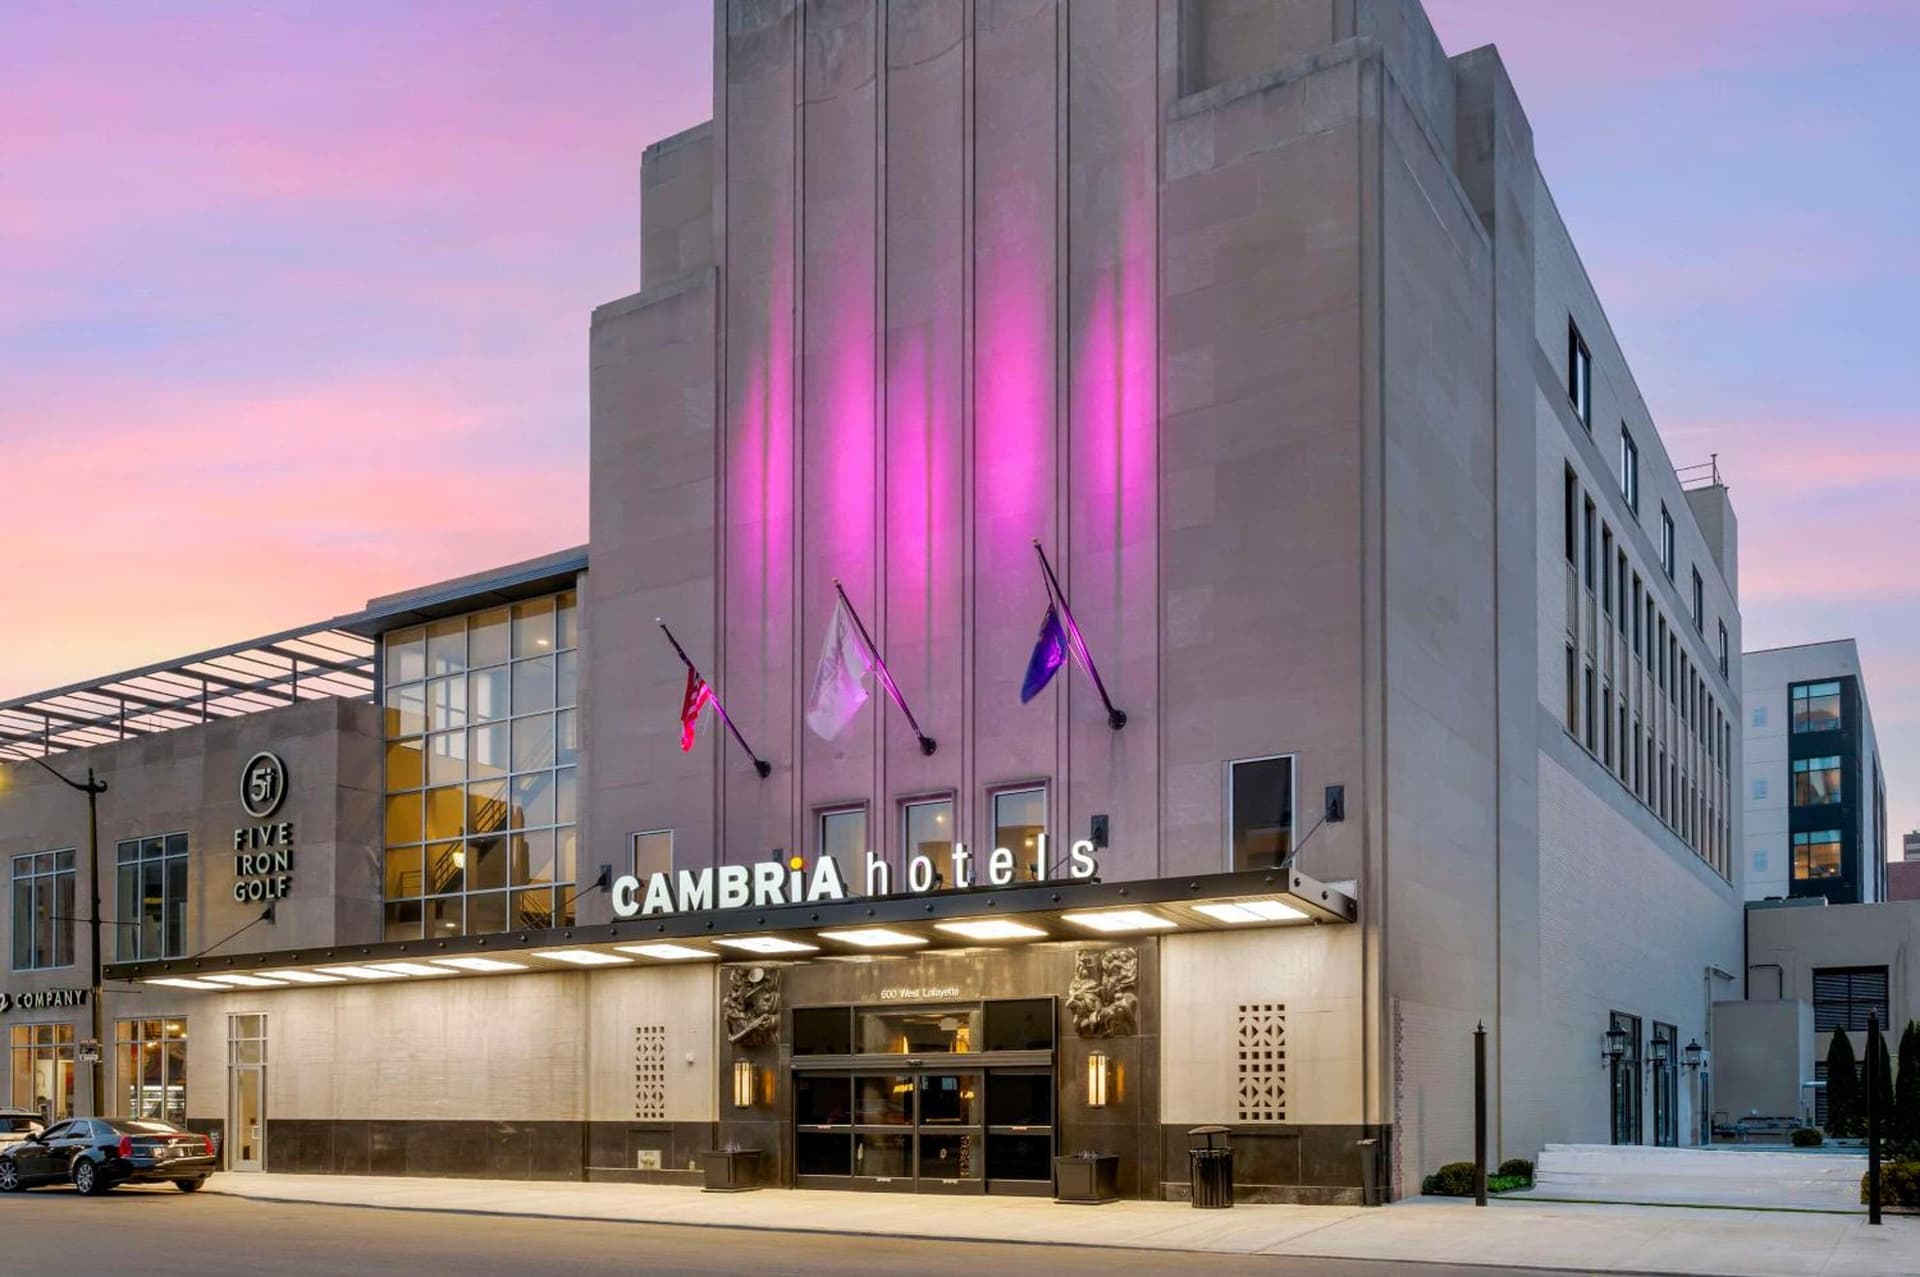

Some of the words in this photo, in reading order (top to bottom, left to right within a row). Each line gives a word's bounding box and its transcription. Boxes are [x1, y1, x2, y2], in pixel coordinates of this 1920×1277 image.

[234, 823, 289, 850] FIVE
[234, 850, 288, 876] IRON
[866, 832, 1095, 896] hotels
[233, 876, 287, 902] GOLF
[16, 990, 82, 1008] COMPANY
[881, 988, 897, 999] 600
